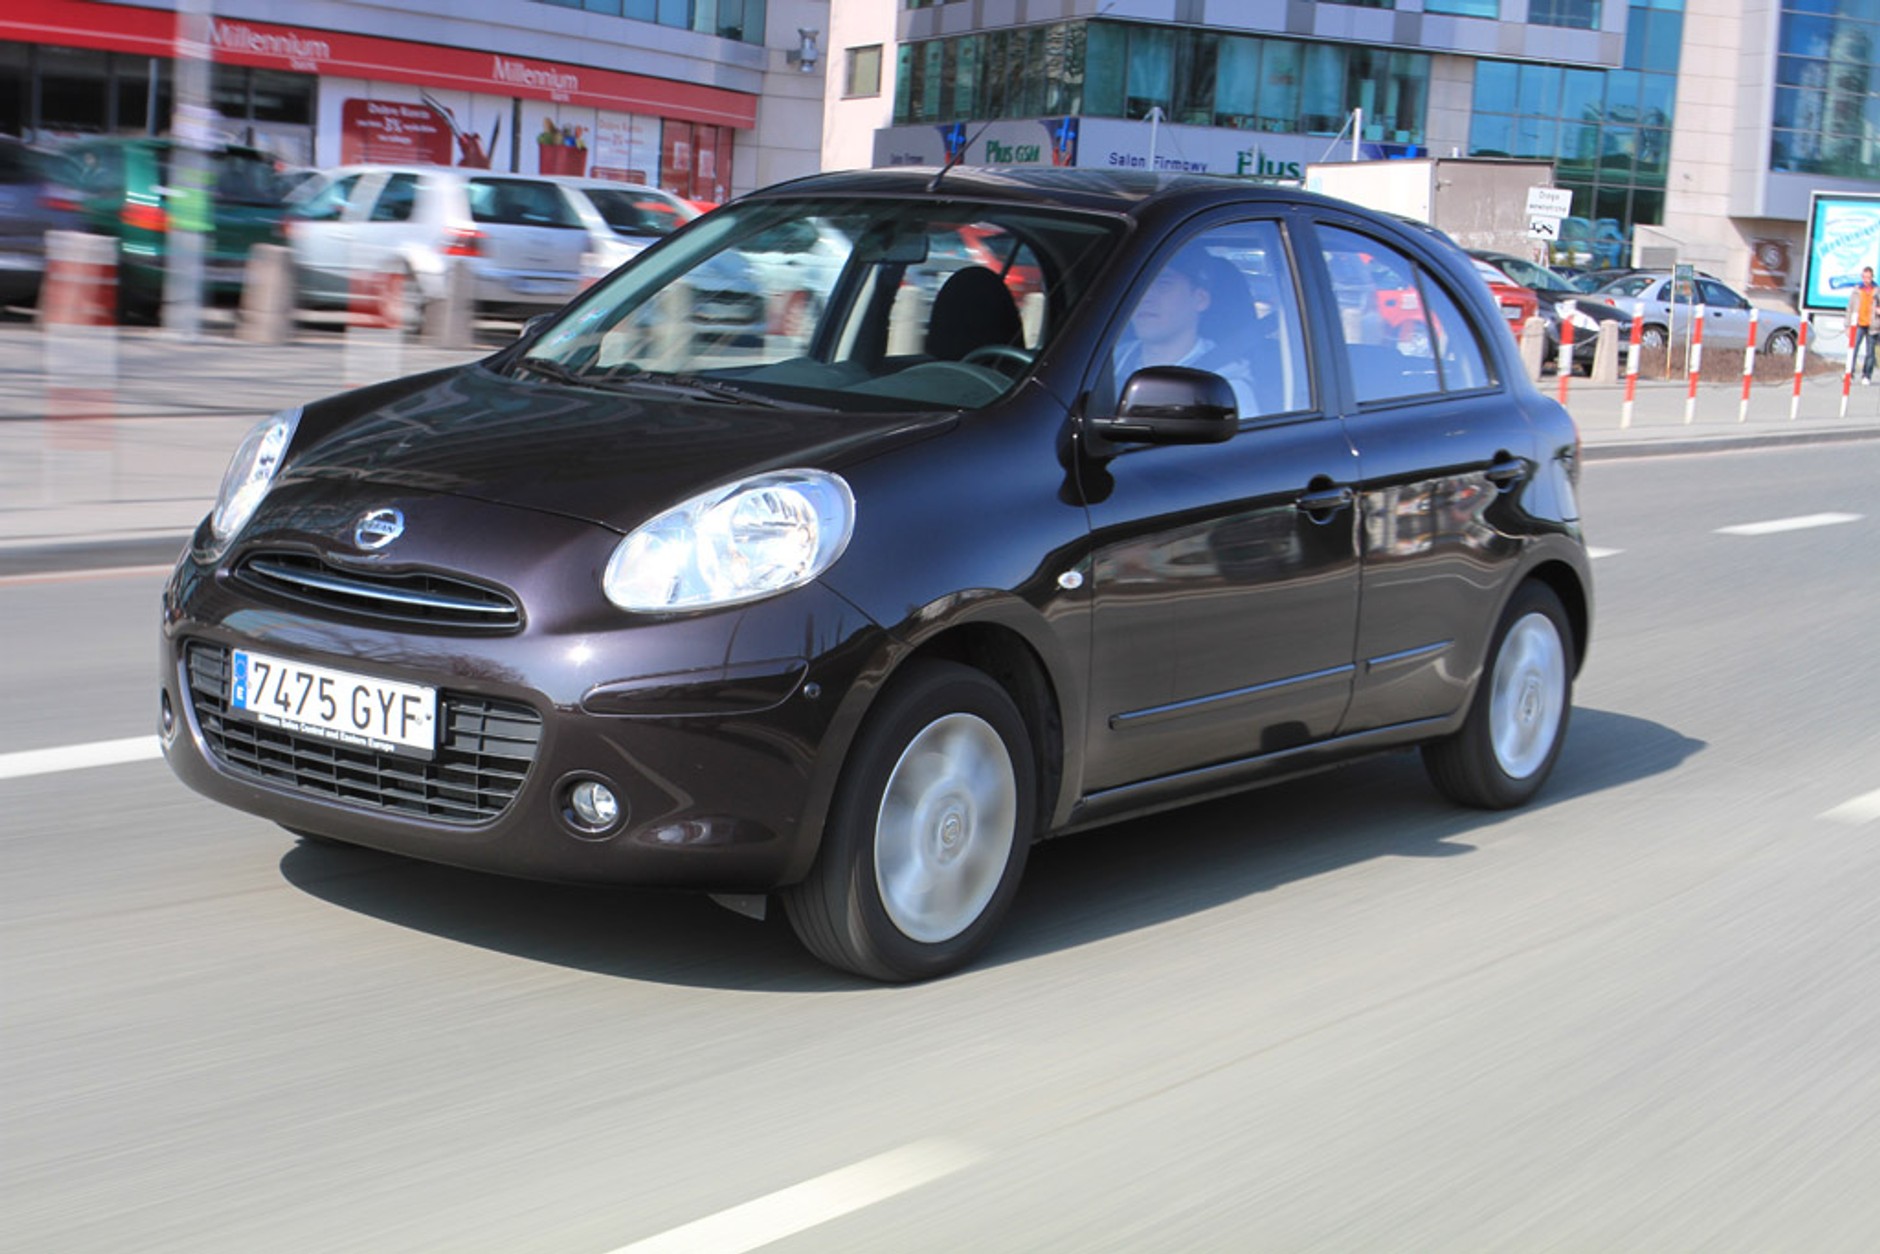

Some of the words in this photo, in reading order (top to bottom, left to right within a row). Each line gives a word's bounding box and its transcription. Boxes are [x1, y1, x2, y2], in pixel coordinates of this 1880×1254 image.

[207, 19, 330, 59] Millennium
[492, 54, 578, 92] Millennium
[986, 139, 1013, 164] Plus
[1015, 144, 1041, 163] GSM
[1108, 151, 1147, 167] Salon
[1154, 155, 1209, 174] Firmowy
[1237, 149, 1301, 177] Plus
[236, 687, 244, 700] E
[254, 661, 337, 722] 7475
[351, 684, 422, 739] GYF
